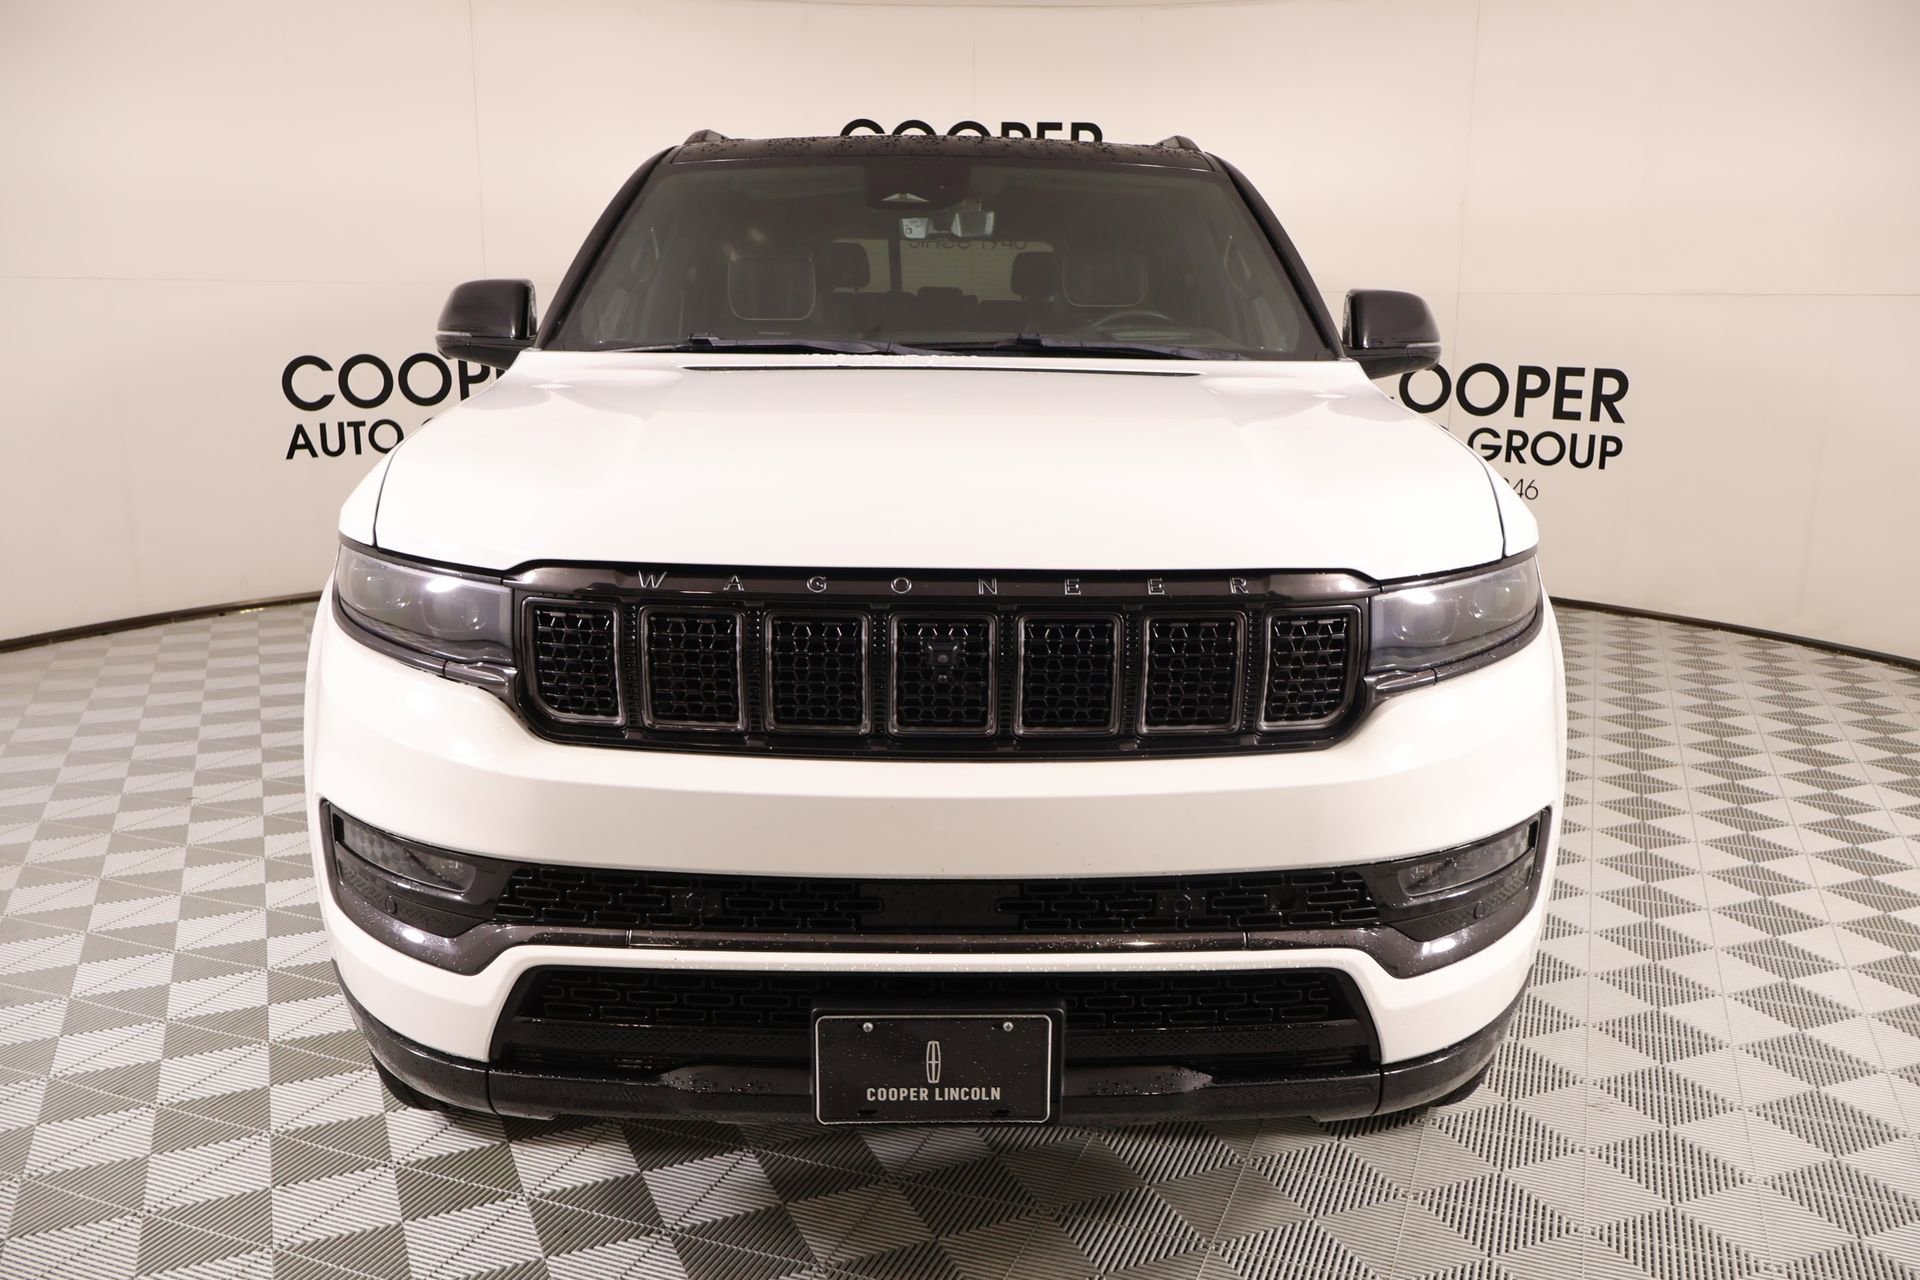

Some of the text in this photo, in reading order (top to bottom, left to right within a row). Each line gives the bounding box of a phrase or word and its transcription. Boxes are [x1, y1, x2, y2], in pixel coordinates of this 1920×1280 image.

[282, 353, 506, 411] COOP
[1389, 362, 1629, 424] OOPER
[286, 418, 404, 460] AUTO
[1467, 427, 1623, 470] GROUP
[1503, 477, 1539, 500] 46
[638, 570, 1249, 596] WAGONEER
[866, 1087, 1001, 1101] COOPER LINCOLN
